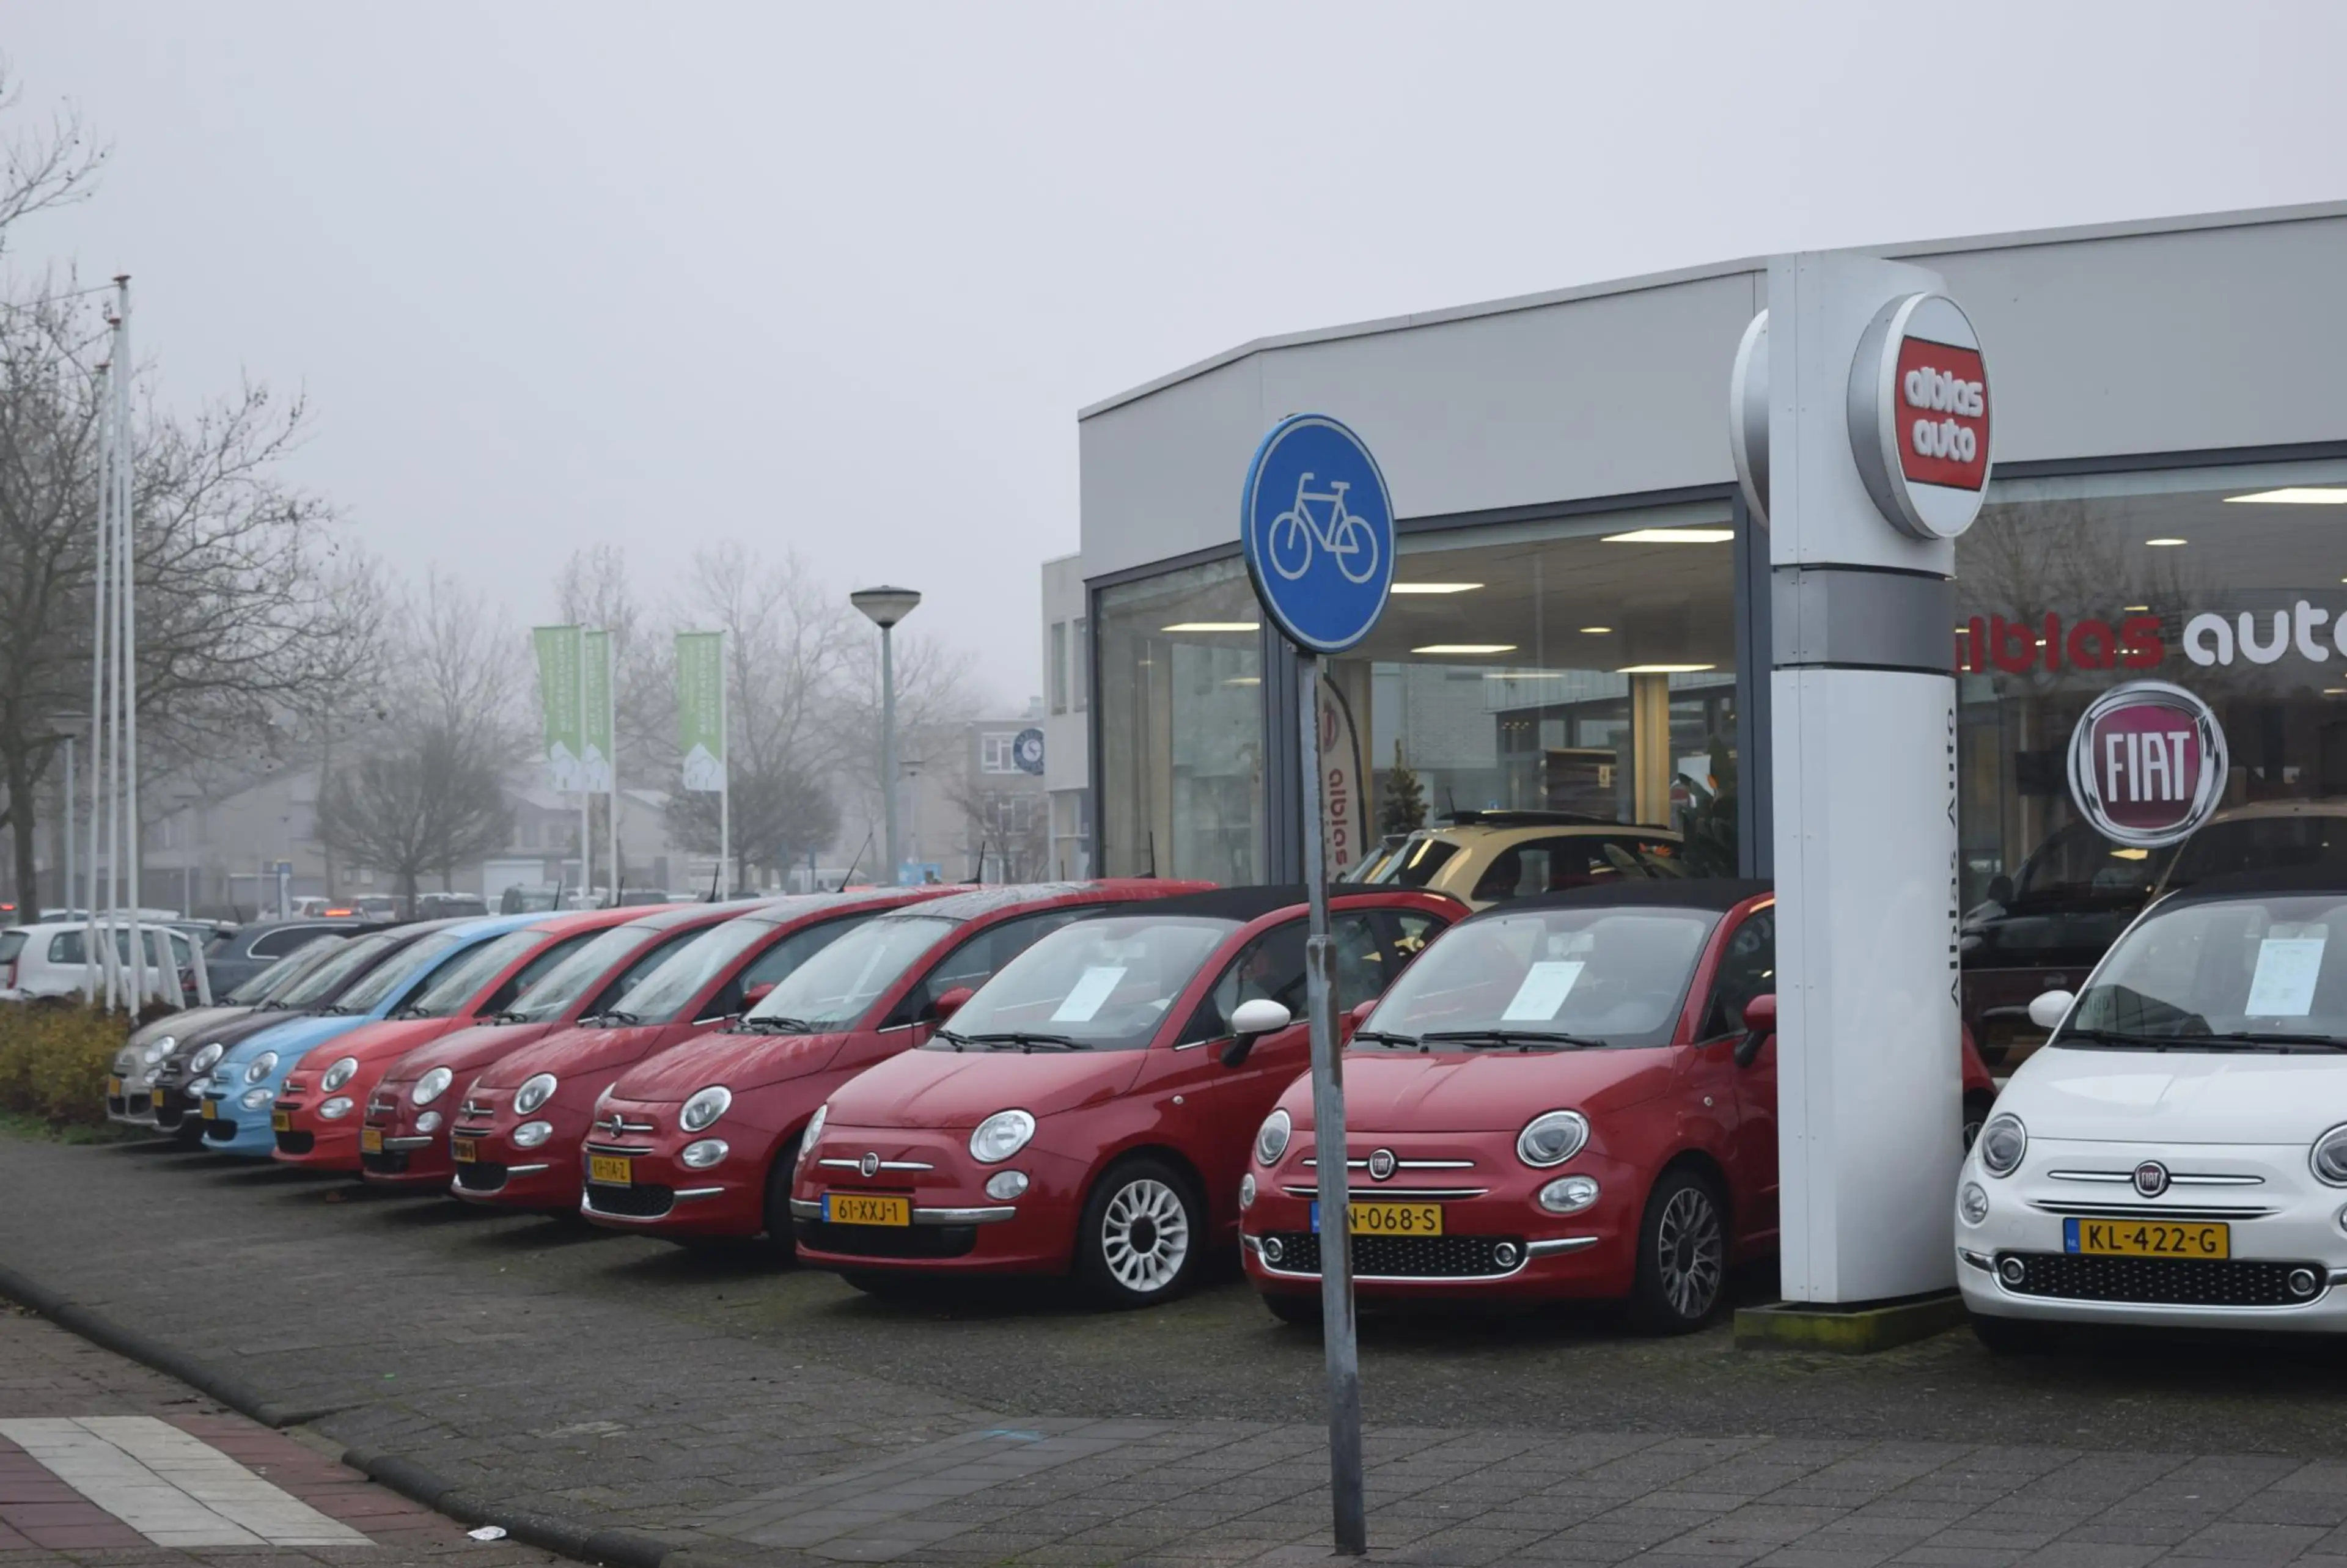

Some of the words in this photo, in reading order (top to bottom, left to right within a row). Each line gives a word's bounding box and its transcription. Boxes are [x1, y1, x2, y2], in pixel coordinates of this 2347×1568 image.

[1904, 367, 1983, 417] alblas
[1912, 418, 1976, 463] auto
[1955, 611, 2164, 676] lblas
[2183, 599, 2347, 666] aut
[2106, 731, 2190, 802] FIAT
[1329, 768, 1348, 865] alblas
[2142, 1172, 2159, 1188] FIAT
[839, 1200, 897, 1222] 61-XXJ-1
[1348, 1207, 1436, 1231] N-068-S
[2088, 1225, 2217, 1253] KL-422-G
